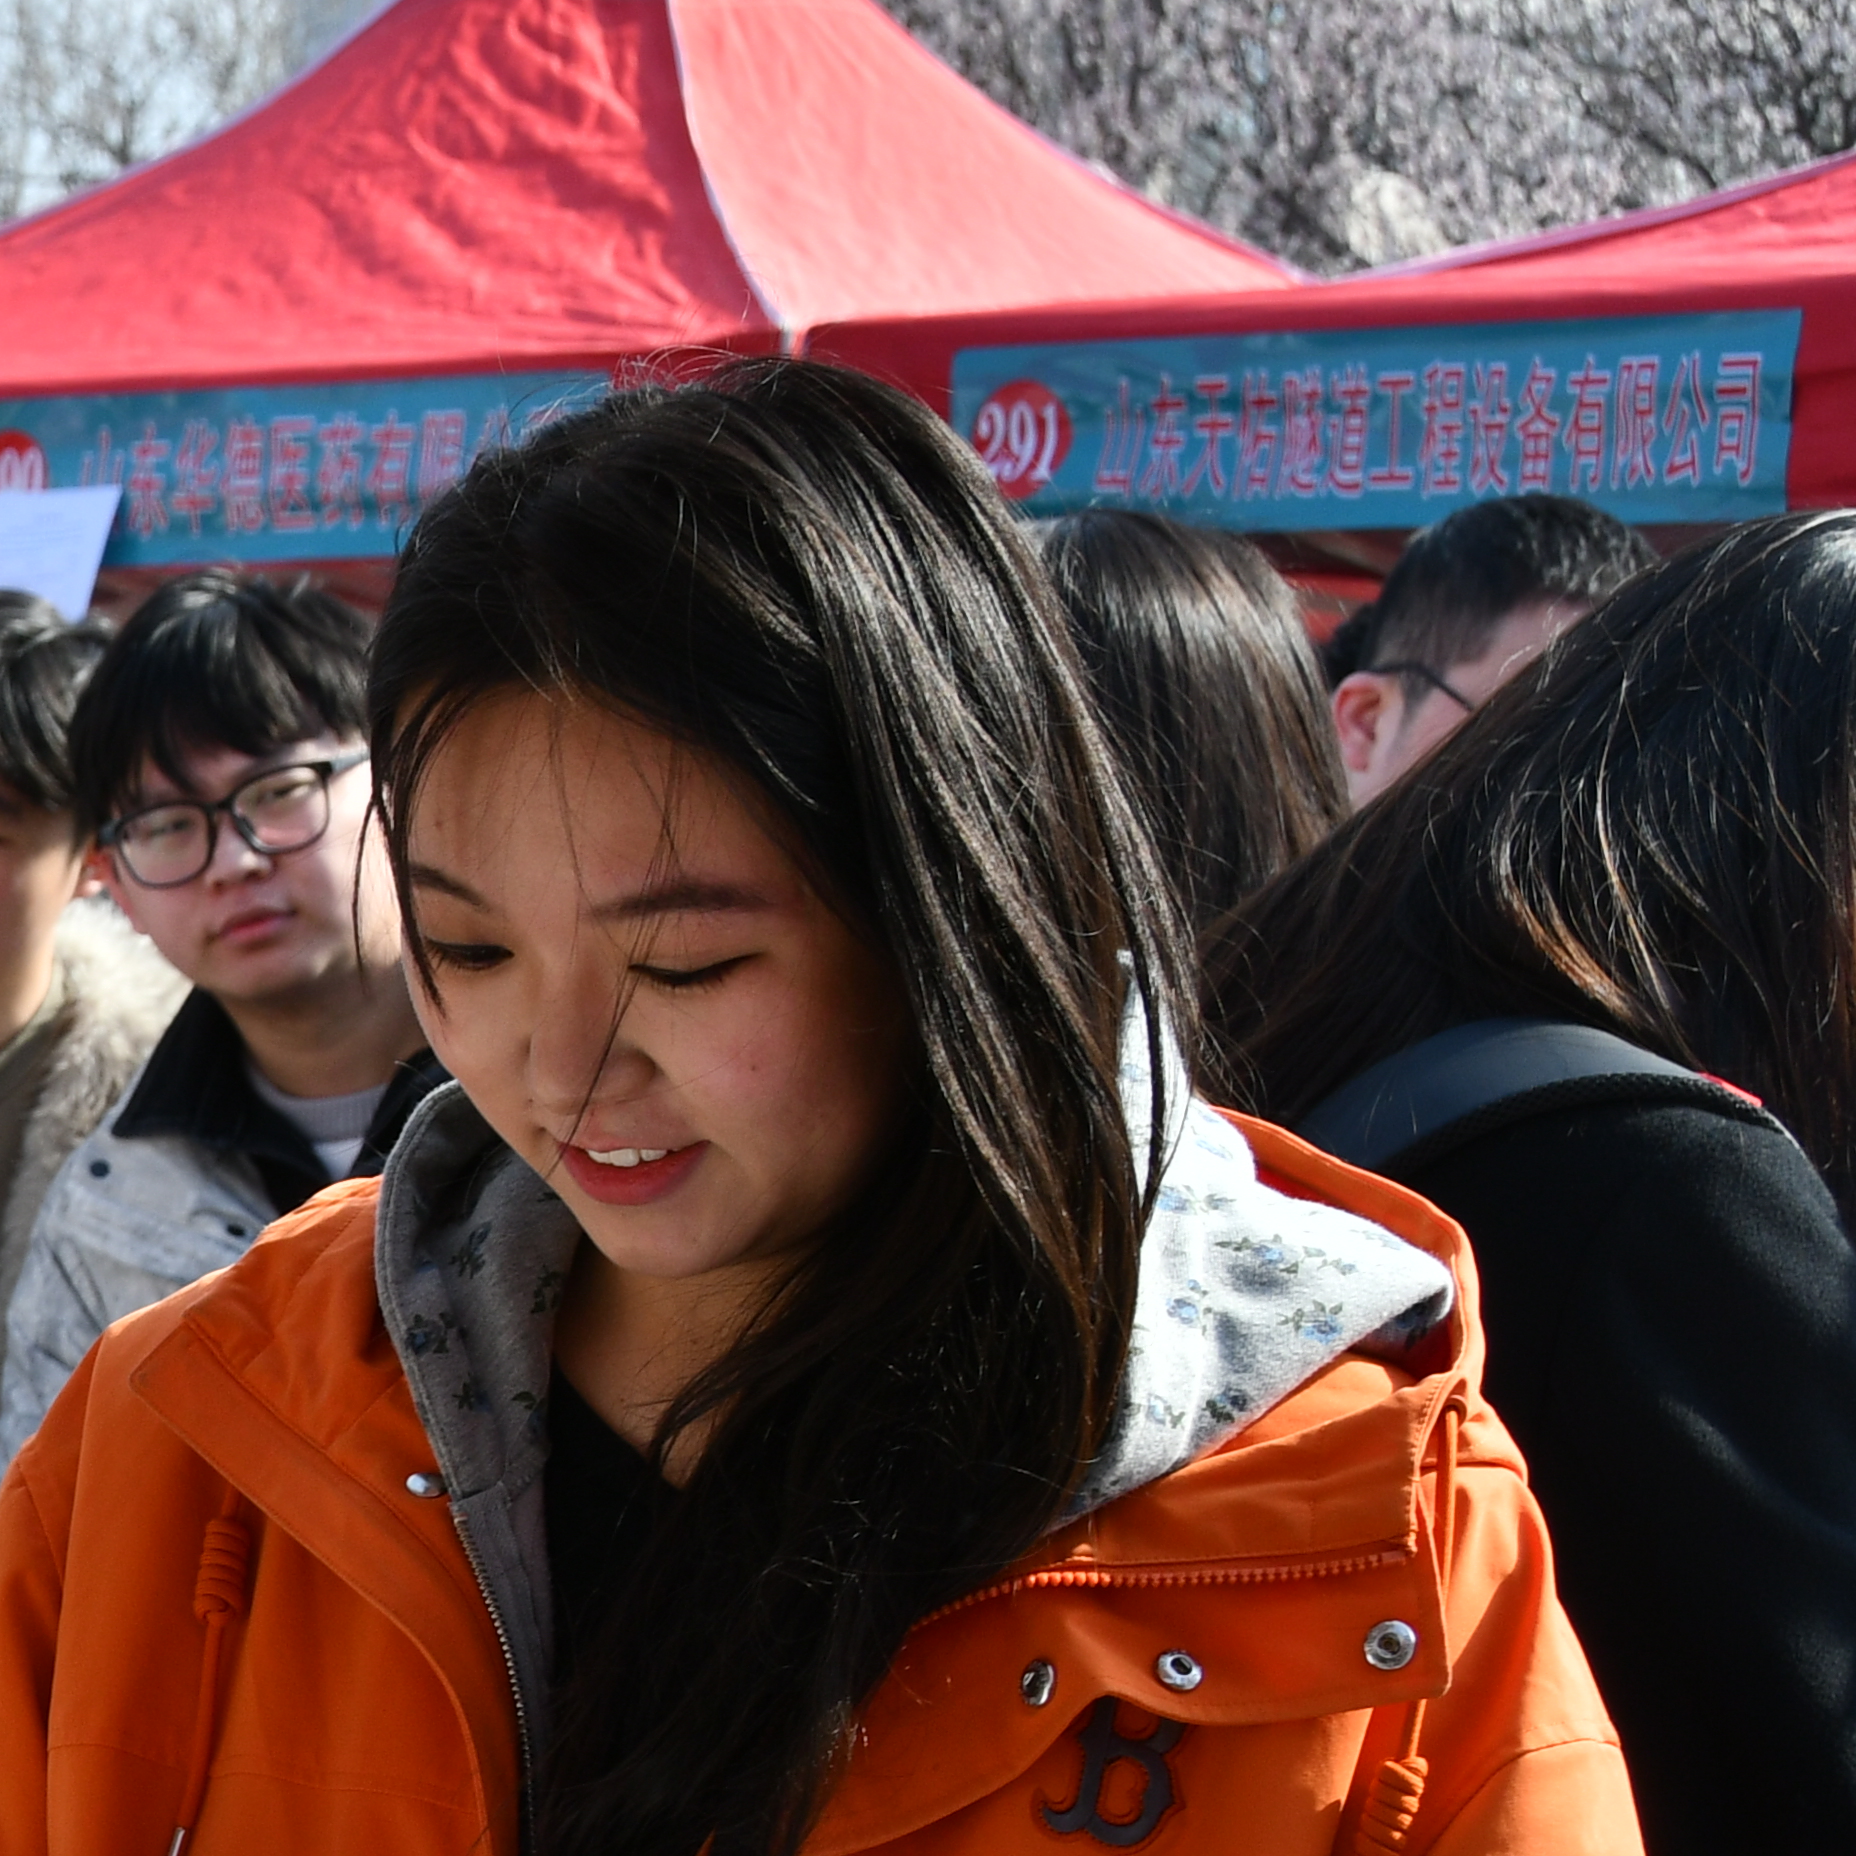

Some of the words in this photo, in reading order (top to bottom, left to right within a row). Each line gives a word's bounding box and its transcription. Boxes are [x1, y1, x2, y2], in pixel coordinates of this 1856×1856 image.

[973, 392, 1061, 486] 291
[1095, 348, 1764, 500] 山东天佑隧道工程设备有限公司
